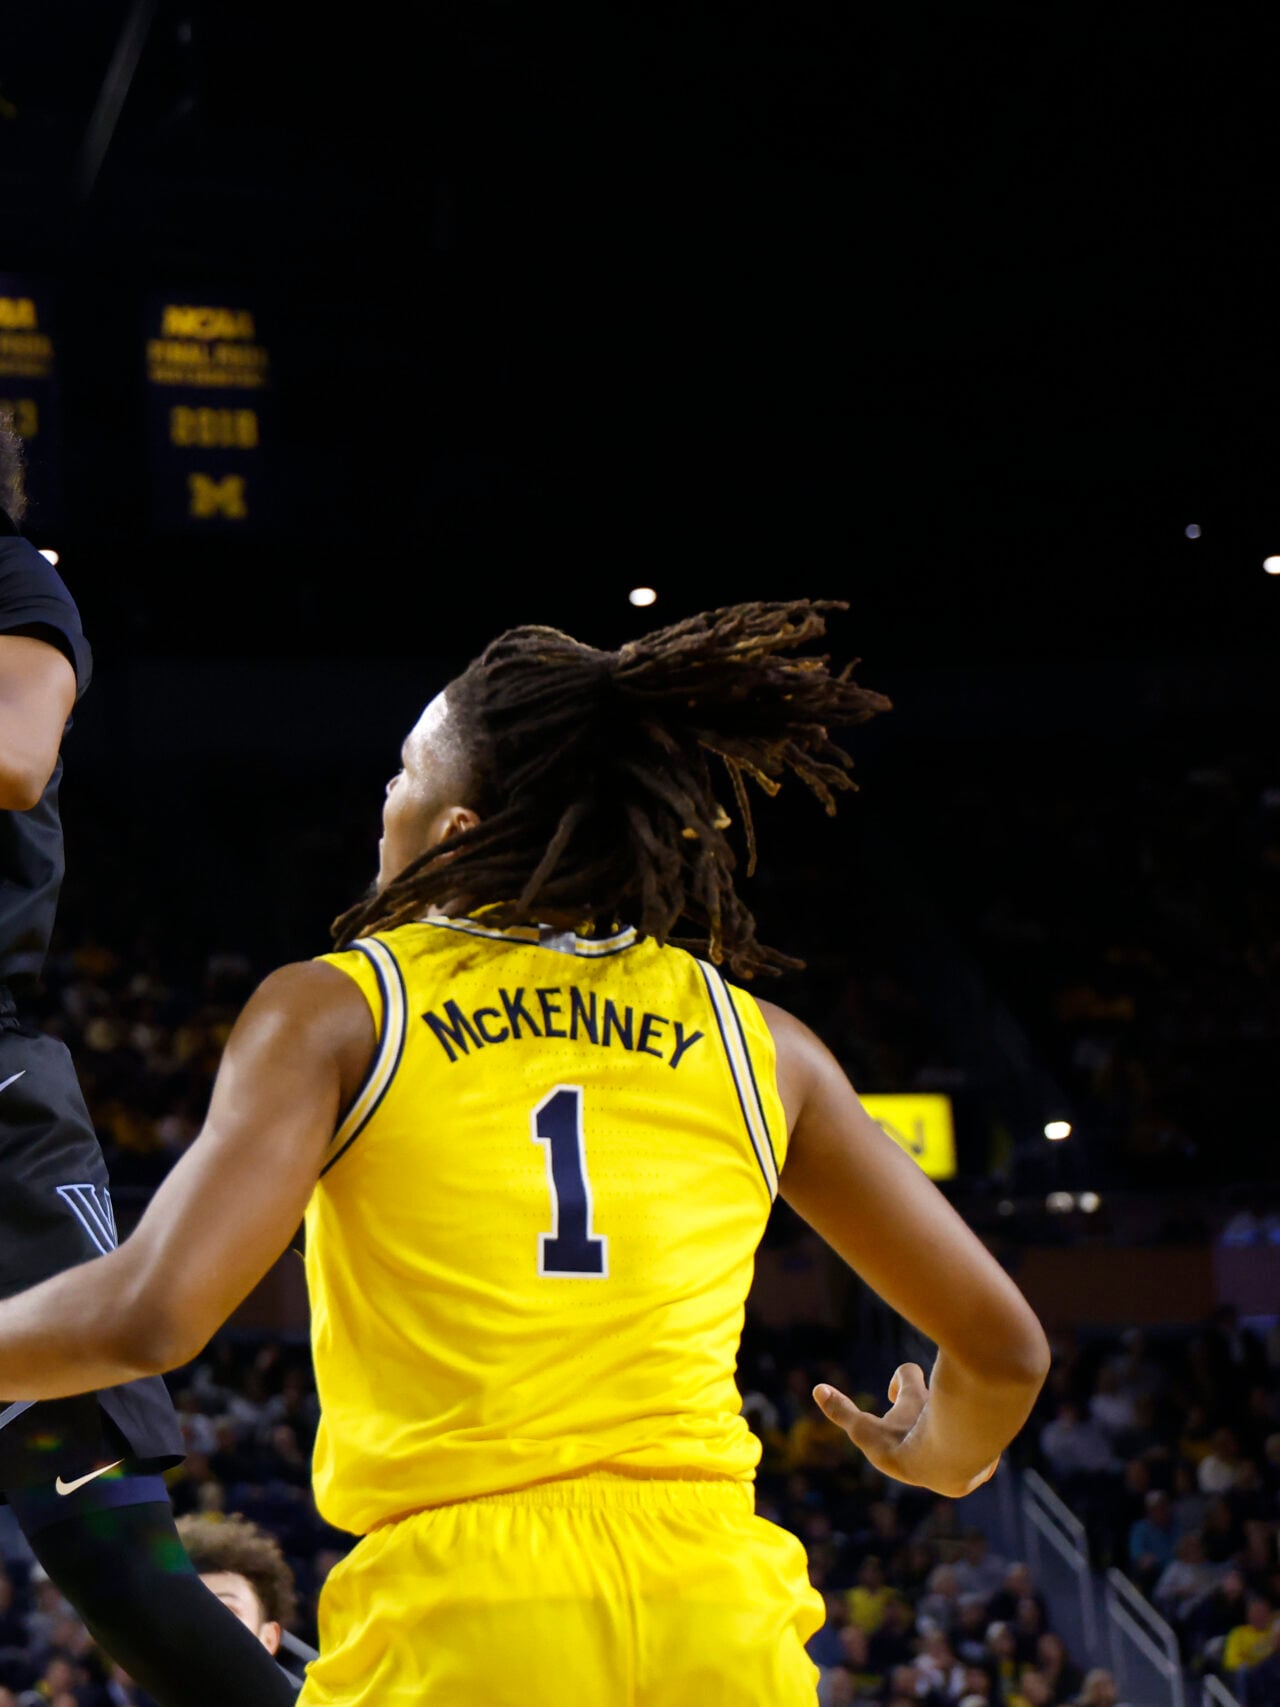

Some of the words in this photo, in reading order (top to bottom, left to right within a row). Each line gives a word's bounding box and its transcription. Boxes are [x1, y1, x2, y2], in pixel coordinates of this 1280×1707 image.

[187, 472, 249, 522] M
[421, 986, 704, 1069] McKENNEY
[529, 1083, 610, 1279] 1
